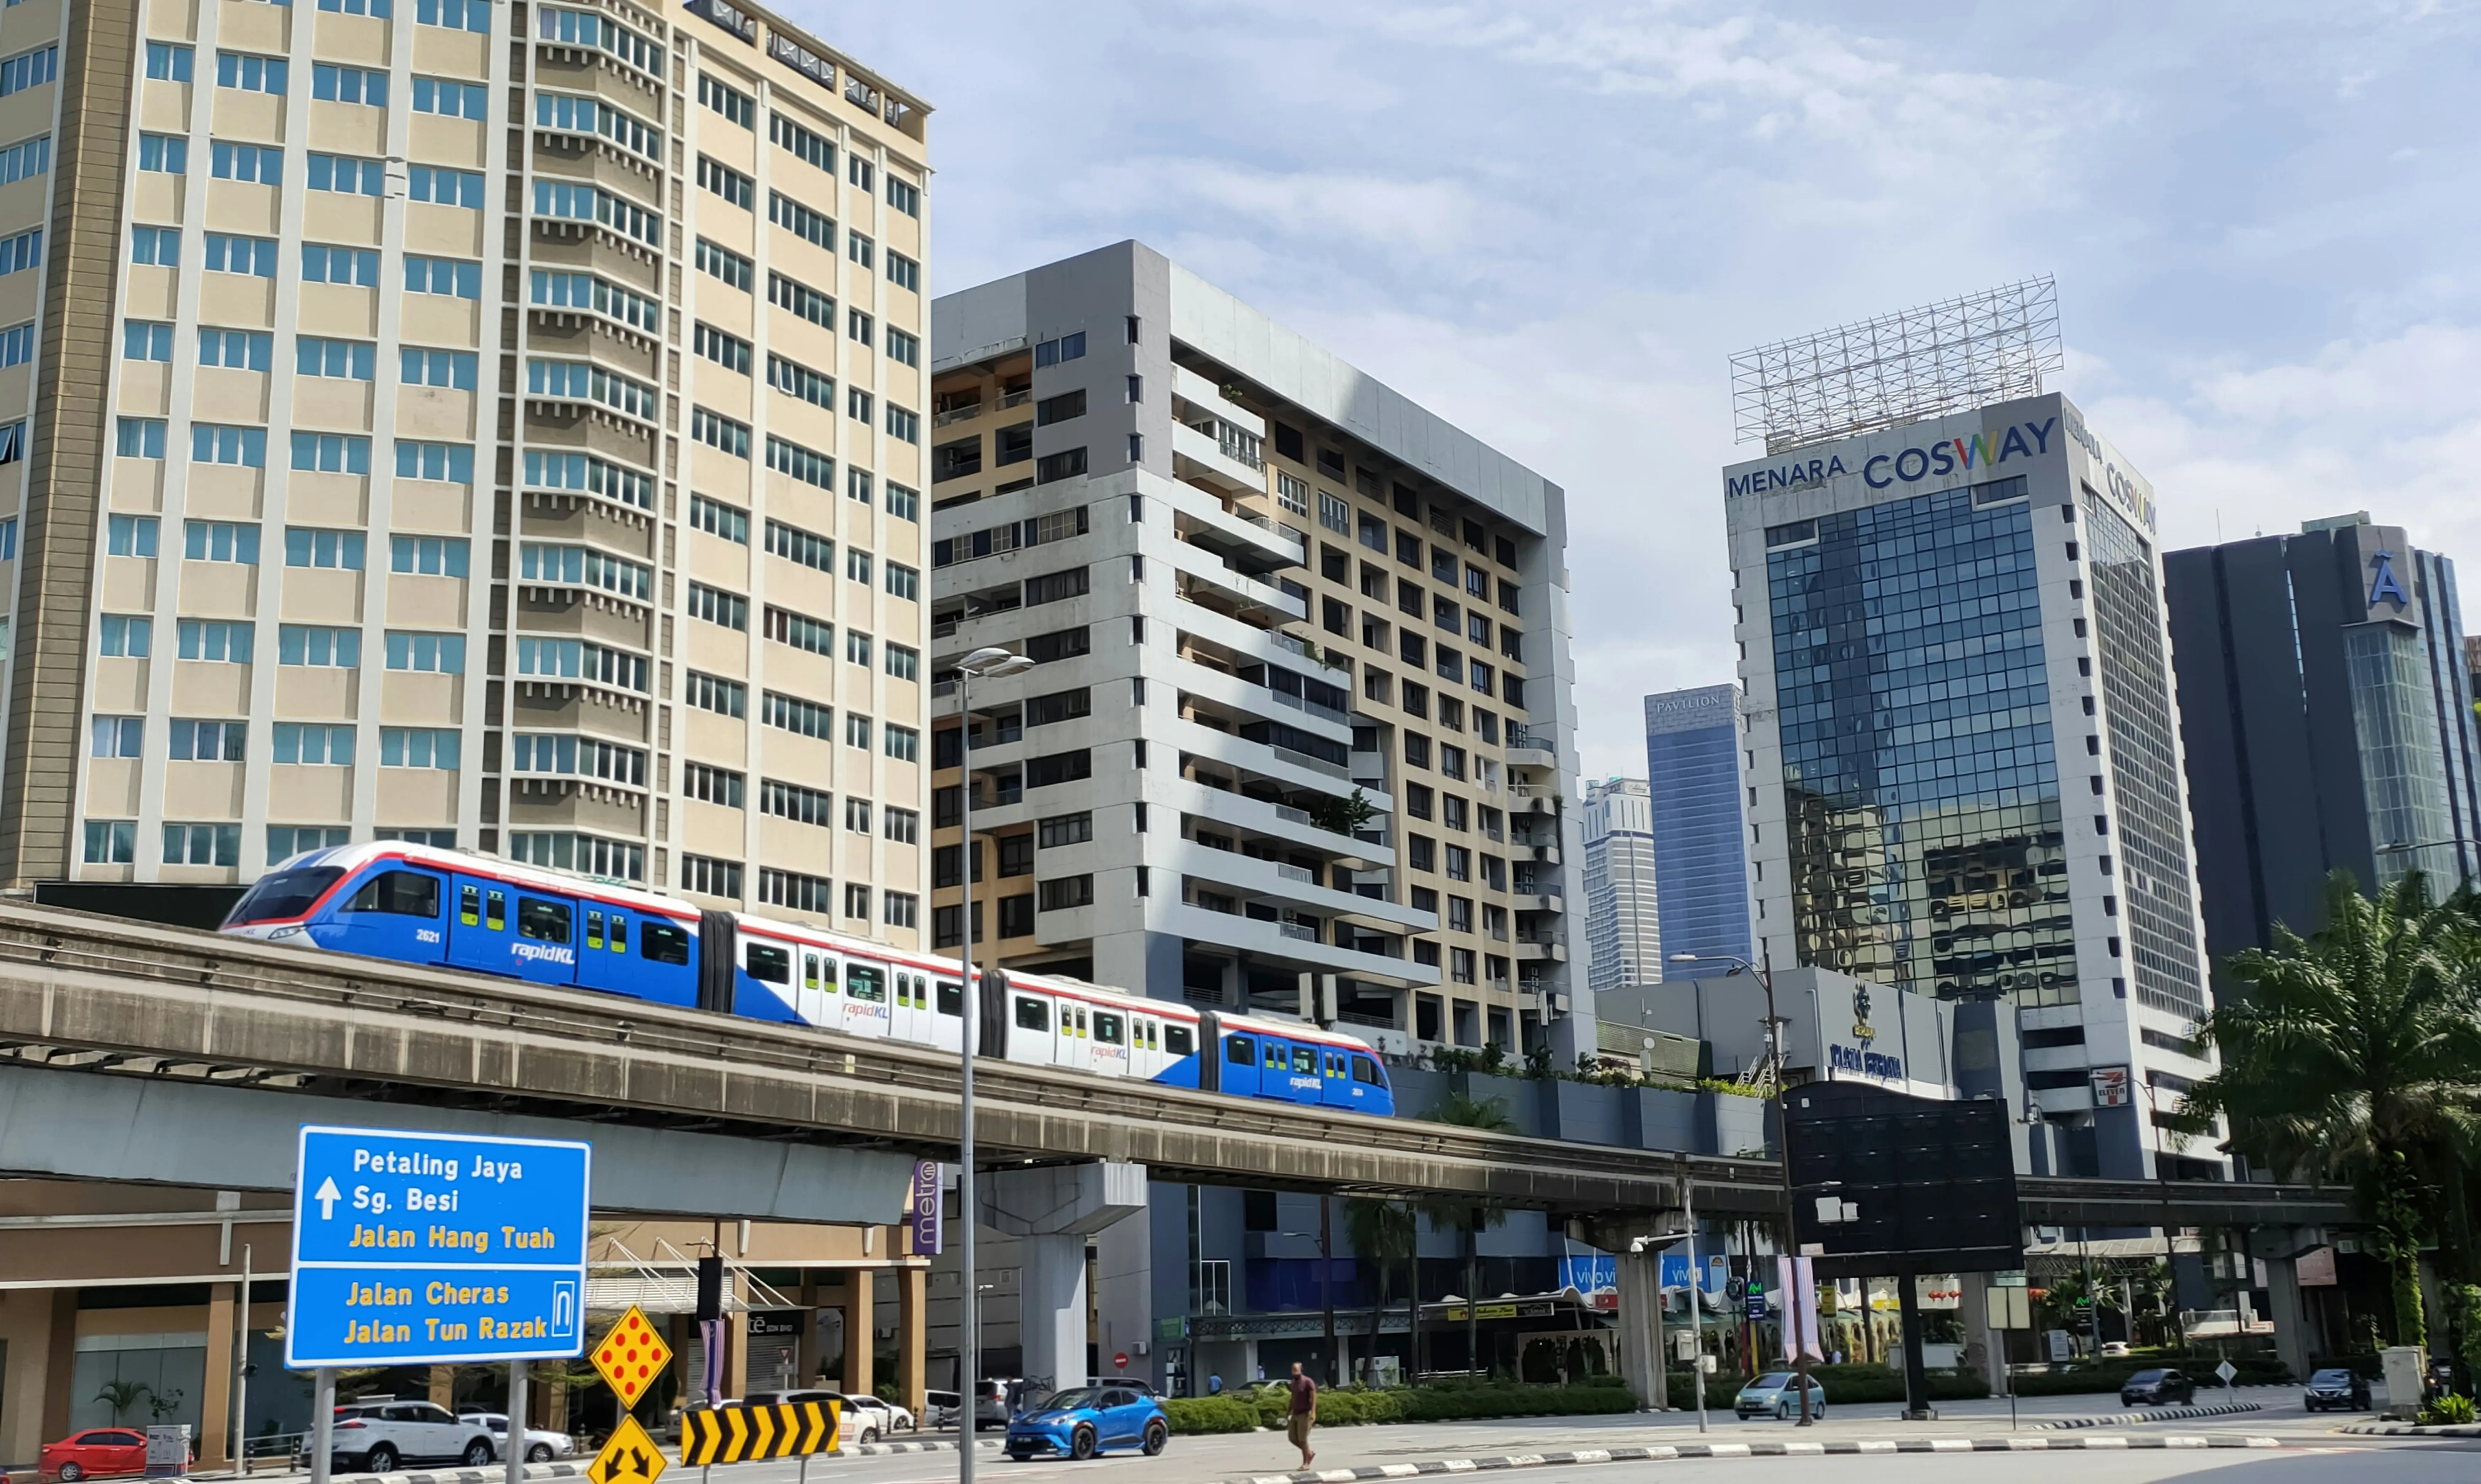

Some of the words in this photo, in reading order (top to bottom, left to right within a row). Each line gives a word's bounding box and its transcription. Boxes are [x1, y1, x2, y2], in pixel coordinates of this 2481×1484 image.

[1729, 455, 1847, 498] MENARA
[1864, 417, 2057, 489] COSWAY
[2107, 463, 2156, 535] COSWAY
[1657, 695, 1719, 714] PAVILION
[416, 929, 440, 944] 2621
[511, 942, 575, 965] rapidKL
[842, 1003, 888, 1019] rapidKL
[1090, 1046, 1127, 1060] rapidKL
[354, 1149, 458, 1181] Petaling
[471, 1155, 522, 1183] Jaya
[353, 1186, 391, 1214] Sg.
[407, 1188, 458, 1211] Besi
[915, 1162, 936, 1244] metro
[349, 1224, 415, 1248] Jalan
[429, 1226, 488, 1253] Hang
[501, 1226, 555, 1249] Tuah
[1605, 1267, 1616, 1283] vi
[346, 1282, 412, 1306] Jalan
[426, 1282, 508, 1305] Cheras
[344, 1319, 410, 1344] Jalan
[425, 1318, 467, 1341] Tun
[479, 1316, 547, 1339] Razak
